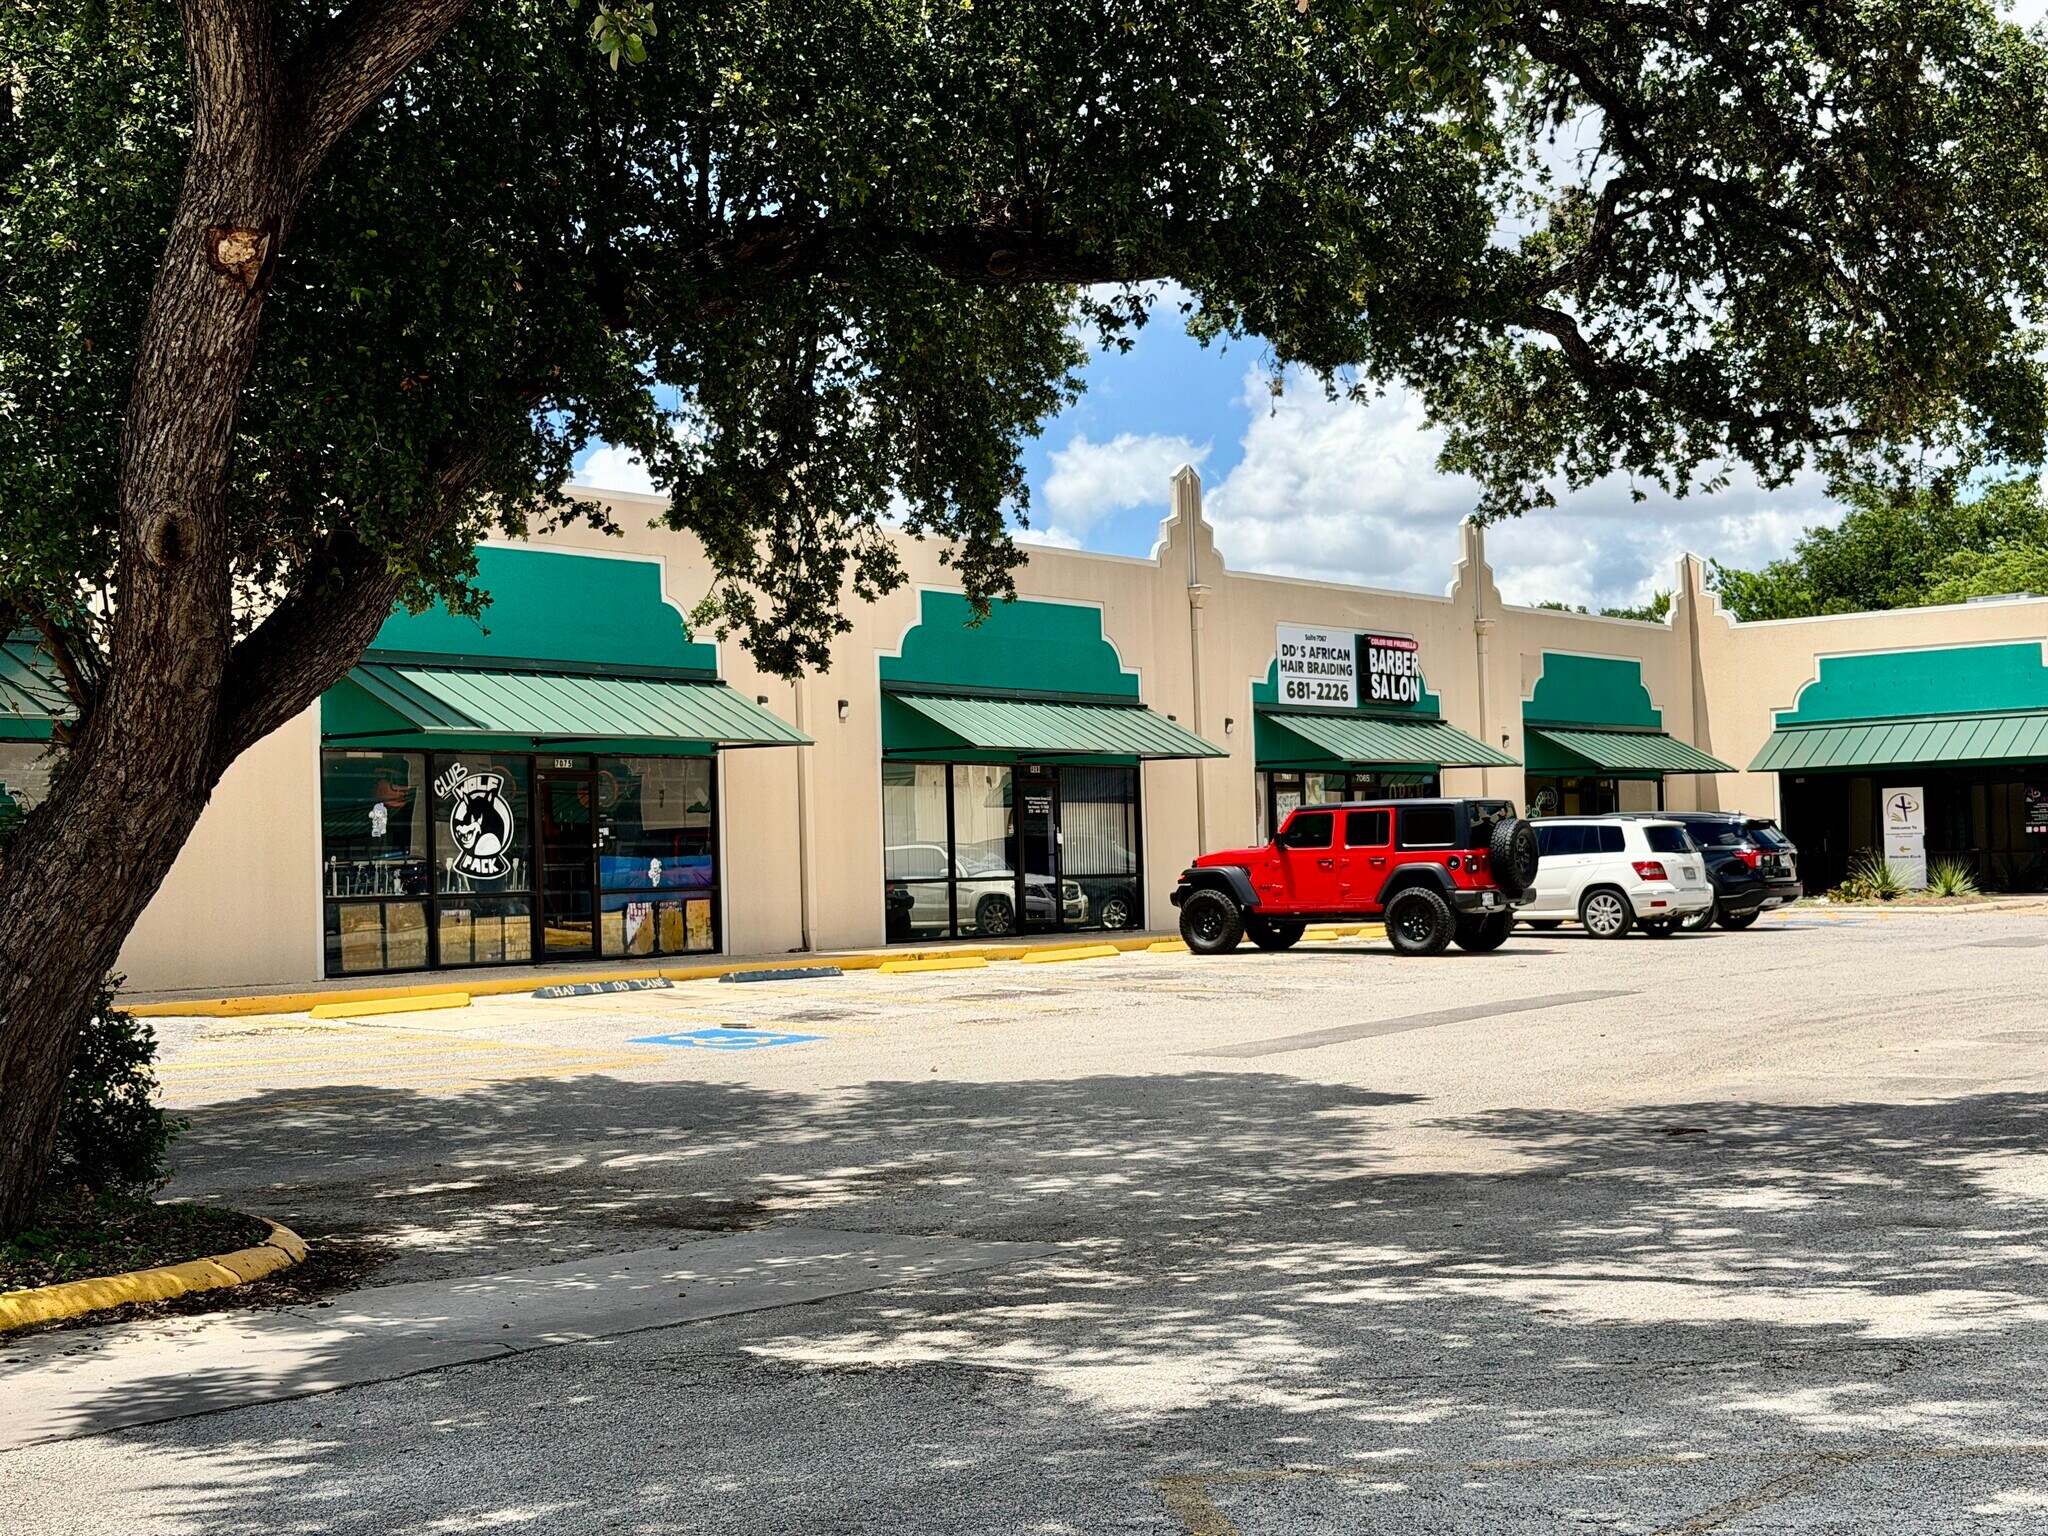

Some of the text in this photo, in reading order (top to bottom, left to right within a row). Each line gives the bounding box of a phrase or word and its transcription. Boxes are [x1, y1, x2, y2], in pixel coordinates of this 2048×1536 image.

[1370, 638, 1386, 646] COLOR
[1281, 644, 1351, 662] DD'S AFRICAN
[1280, 659, 1353, 676] HAIR BRAIDING
[1368, 648, 1420, 677] BARBER
[1286, 681, 1349, 702] 681-2226
[1371, 674, 1420, 702] SALON
[554, 759, 573, 768] 7075
[434, 762, 468, 797] CLUB
[1355, 774, 1371, 782] 7065
[455, 776, 499, 799] WOLF
[462, 857, 499, 874] PACK
[552, 985, 576, 997] HAP
[589, 983, 604, 993] KI
[612, 980, 630, 991] DO
